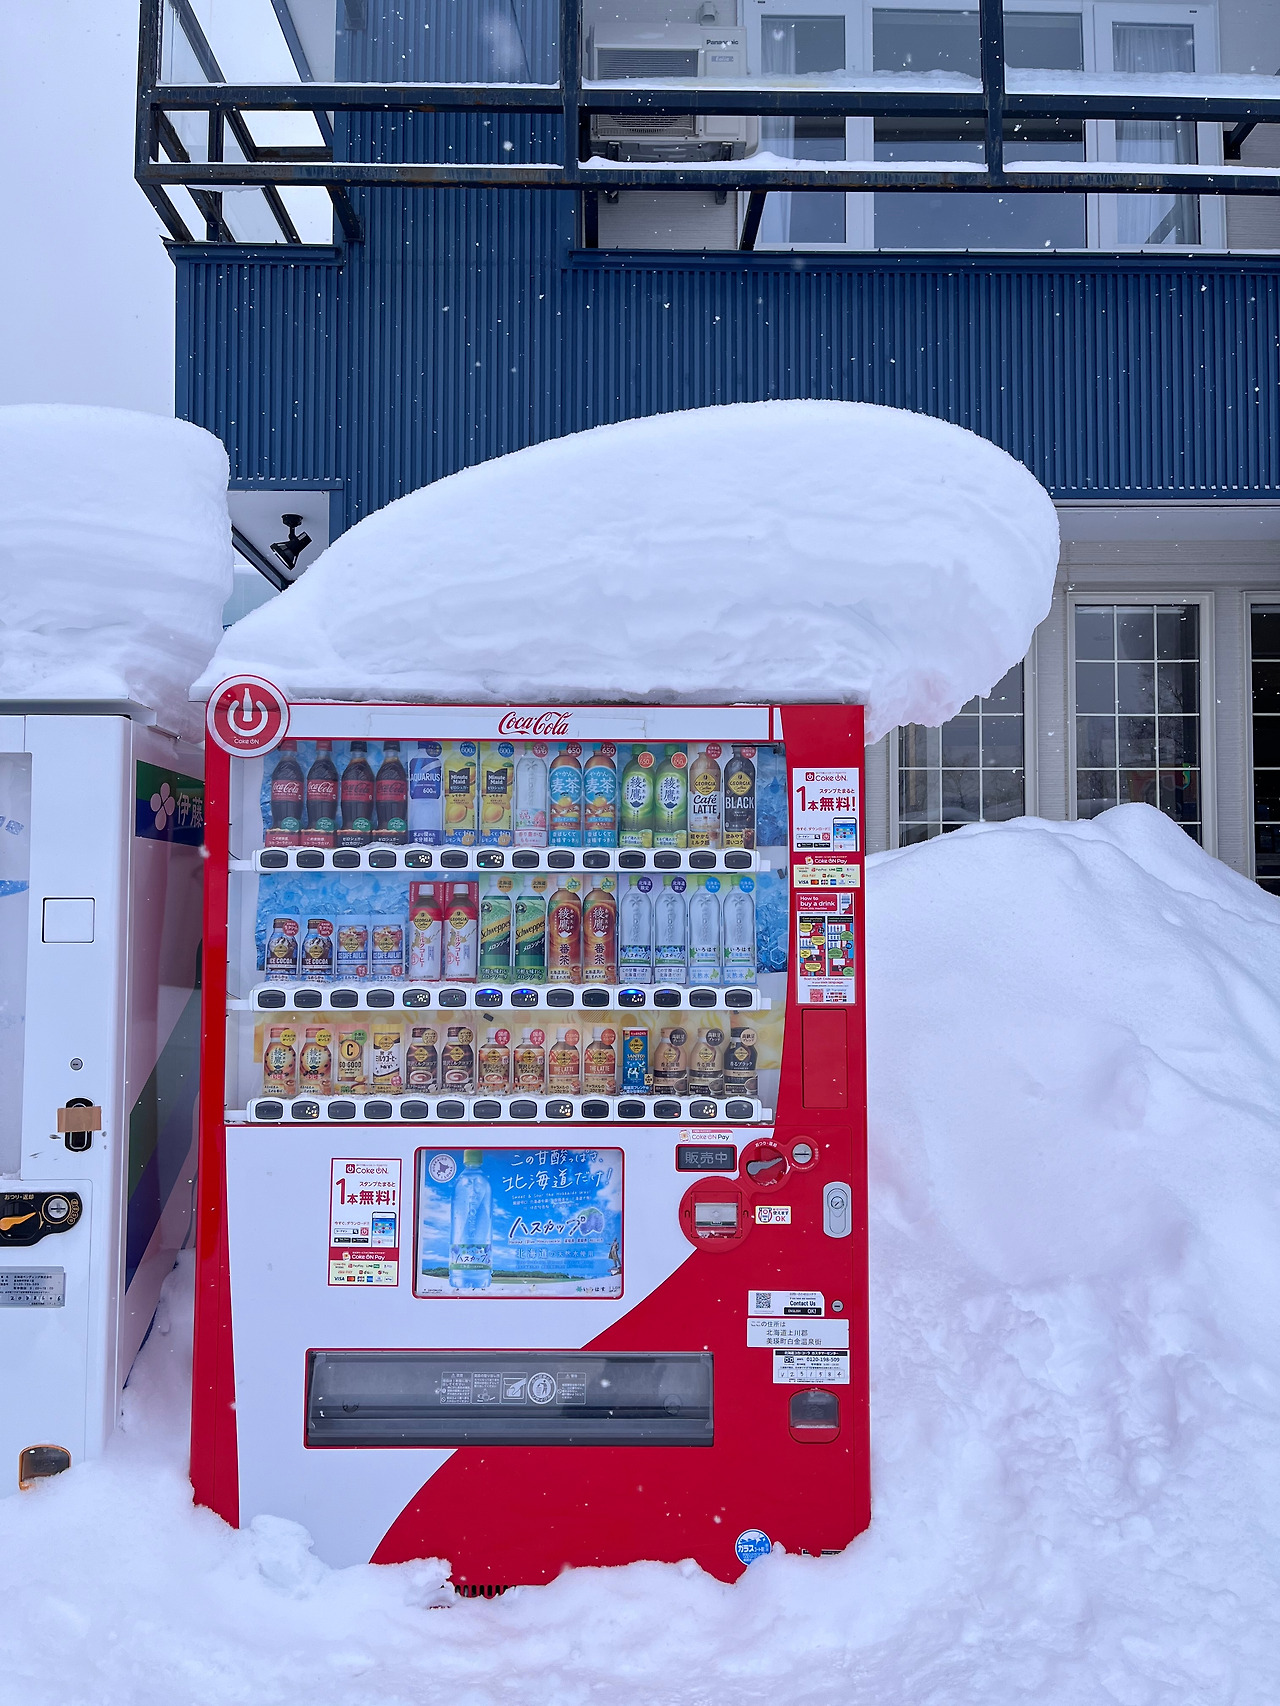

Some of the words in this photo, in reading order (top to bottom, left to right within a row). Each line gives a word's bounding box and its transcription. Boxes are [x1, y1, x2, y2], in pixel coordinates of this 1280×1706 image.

[498, 711, 573, 735] Coca-Cola
[551, 778, 580, 794] 麦茶
[586, 778, 615, 794] 麦茶
[630, 776, 643, 801] 綾鷹
[664, 776, 676, 802] 綾鷹
[835, 773, 847, 782] ON
[177, 792, 203, 828] 伊藤
[693, 795, 717, 804] Café
[693, 805, 717, 814] LATTE
[725, 797, 755, 809] BLACK
[796, 785, 856, 812] 1本無料!
[558, 907, 570, 931] 綾鷹
[593, 907, 605, 931] 綾鷹
[559, 943, 570, 966] 番茶
[594, 943, 605, 966] 番茶
[347, 1044, 353, 1056] C
[685, 1151, 727, 1164] 販売中
[375, 1166, 388, 1174] ON
[502, 1168, 613, 1192] 北海道だけ!
[336, 1178, 396, 1206] 1本無料!
[509, 1216, 587, 1239] ハスカップ
[766, 1329, 808, 1337] 北海道上川郡
[766, 1337, 822, 1346] 美瑛町白金温泉街
